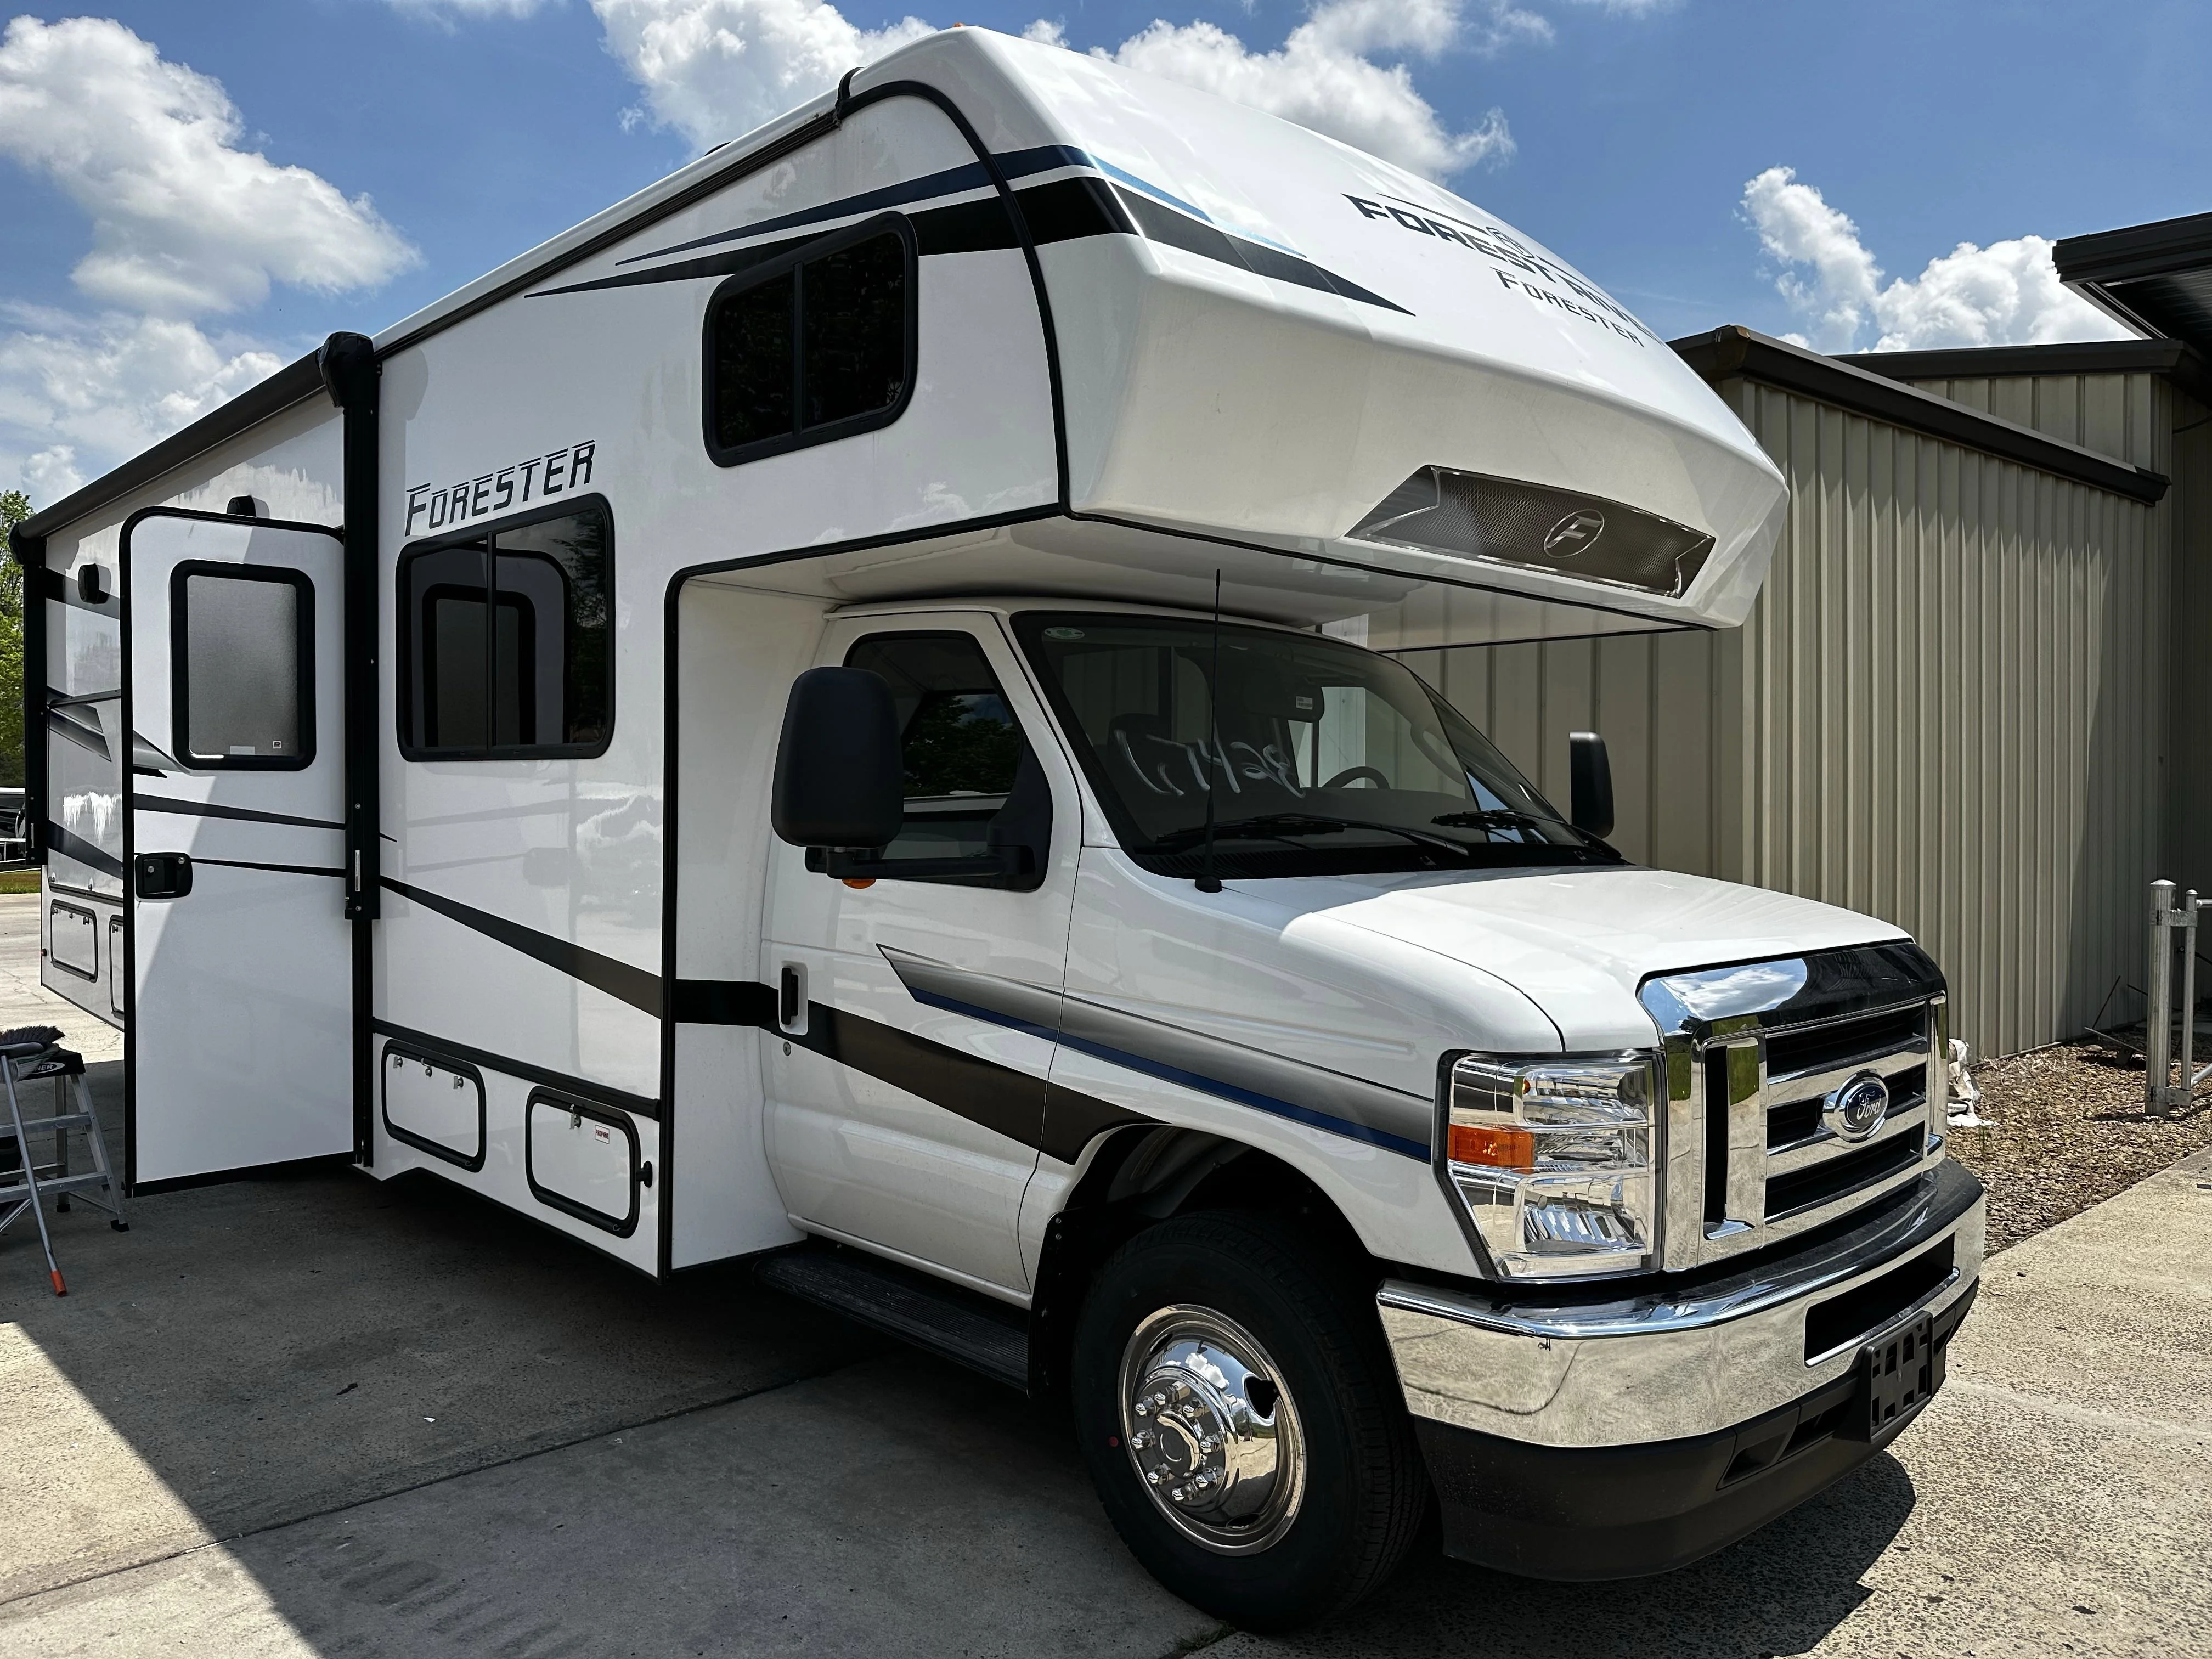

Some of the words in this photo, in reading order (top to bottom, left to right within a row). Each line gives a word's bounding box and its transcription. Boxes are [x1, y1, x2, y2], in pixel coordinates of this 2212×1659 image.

[1340, 193, 1556, 284] FOREST
[1489, 267, 1645, 348] FORESTER
[405, 439, 595, 537] FORESTER
[1857, 1090, 1882, 1120] Ford
